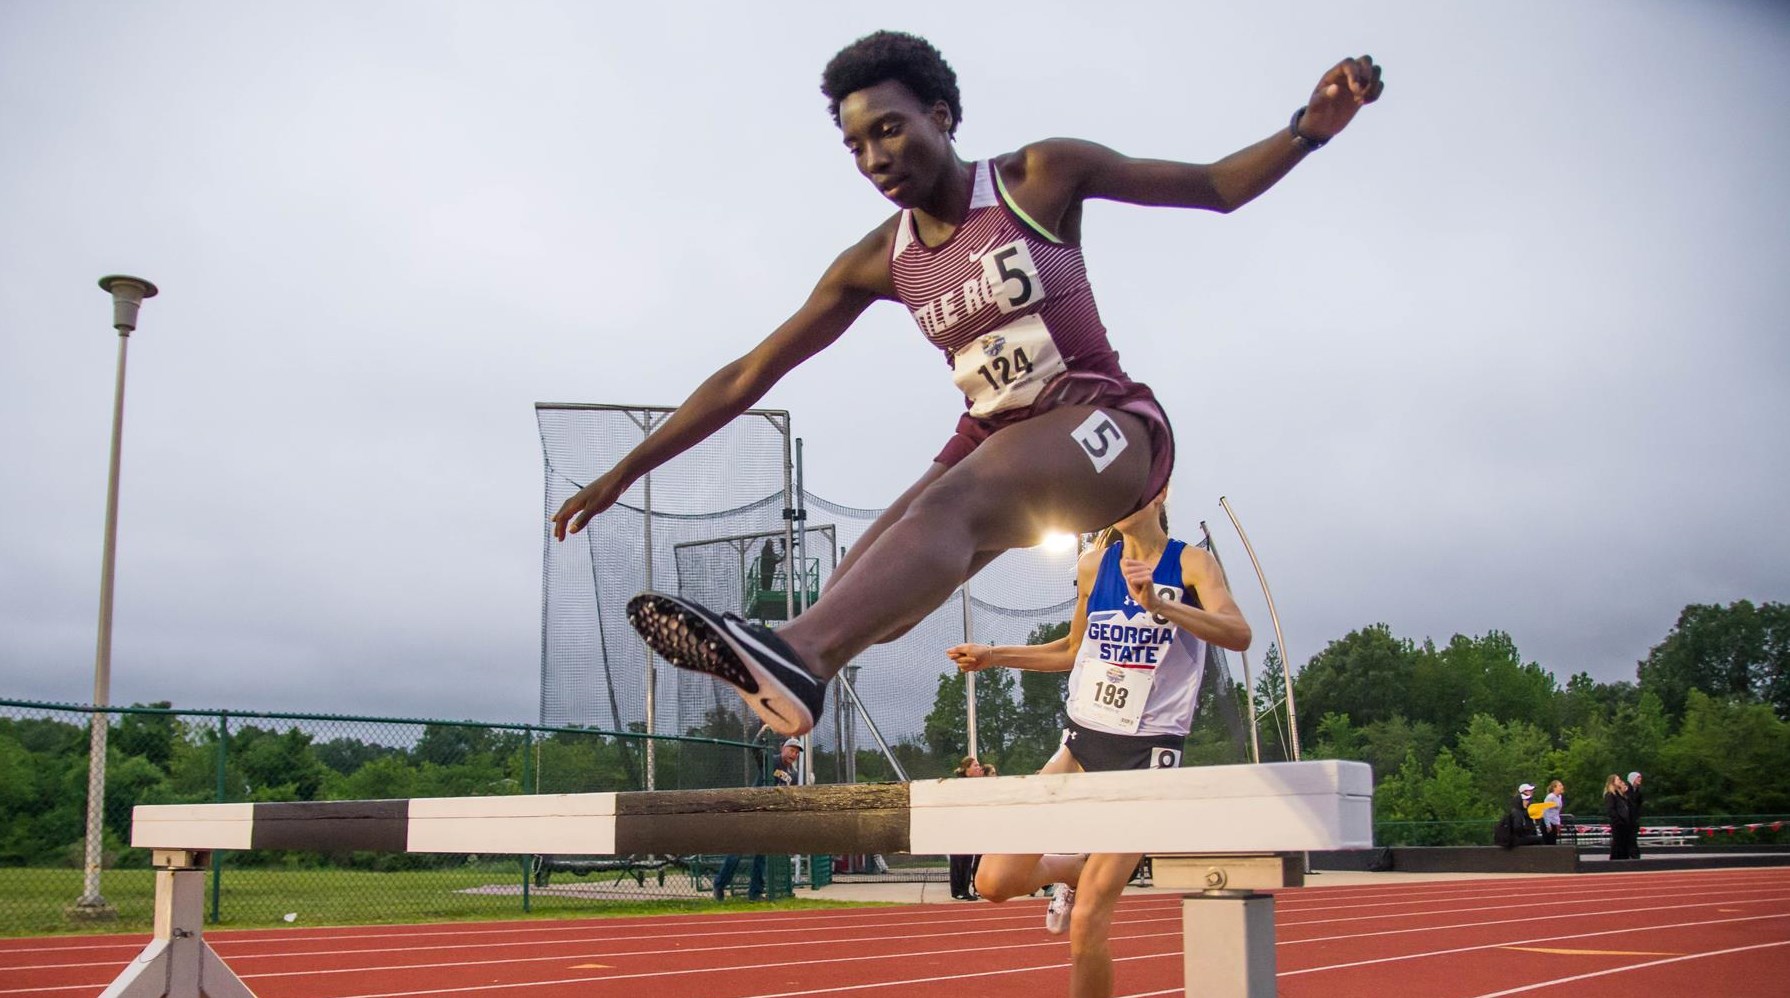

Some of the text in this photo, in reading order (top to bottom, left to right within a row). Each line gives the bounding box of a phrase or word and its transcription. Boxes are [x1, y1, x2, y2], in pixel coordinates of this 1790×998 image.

[993, 246, 1032, 307] 5
[978, 347, 1033, 390] 124
[1082, 419, 1121, 459] 5
[1088, 623, 1173, 644] GEORGIA
[1099, 643, 1159, 664] STATE
[1094, 681, 1129, 709] 193
